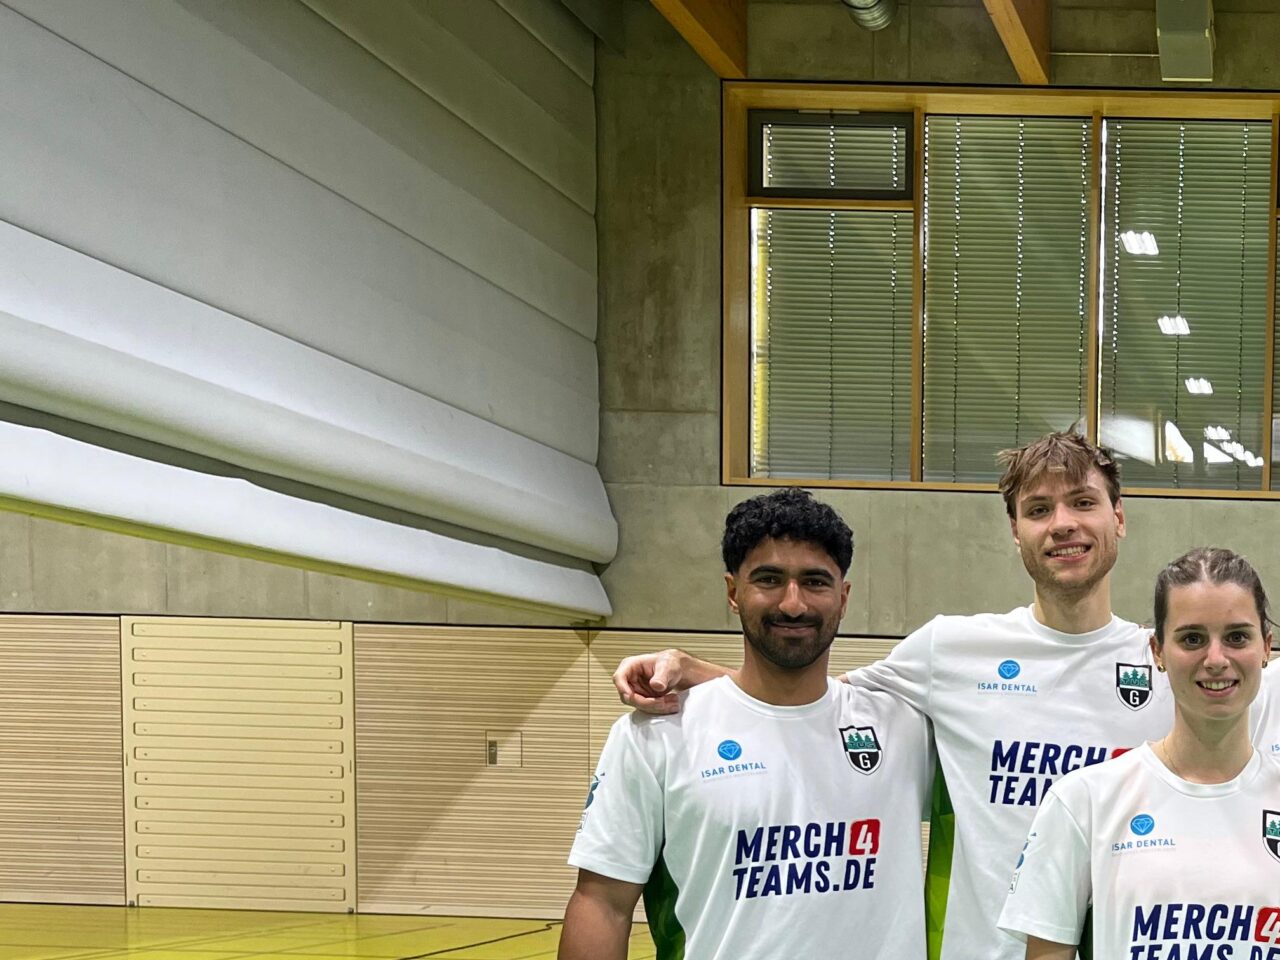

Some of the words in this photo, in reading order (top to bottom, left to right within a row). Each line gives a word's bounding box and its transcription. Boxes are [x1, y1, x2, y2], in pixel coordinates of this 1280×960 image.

[977, 682, 998, 690] ISAR
[1001, 683, 1037, 692] DENTAL
[1129, 690, 1140, 705] G
[859, 752, 871, 769] G
[701, 767, 725, 778] ISAR
[728, 761, 767, 773] DENTAL
[1111, 842, 1133, 852] ISAR
[1136, 838, 1176, 848] DENTAL
[732, 858, 877, 900] TEAMS.DE
